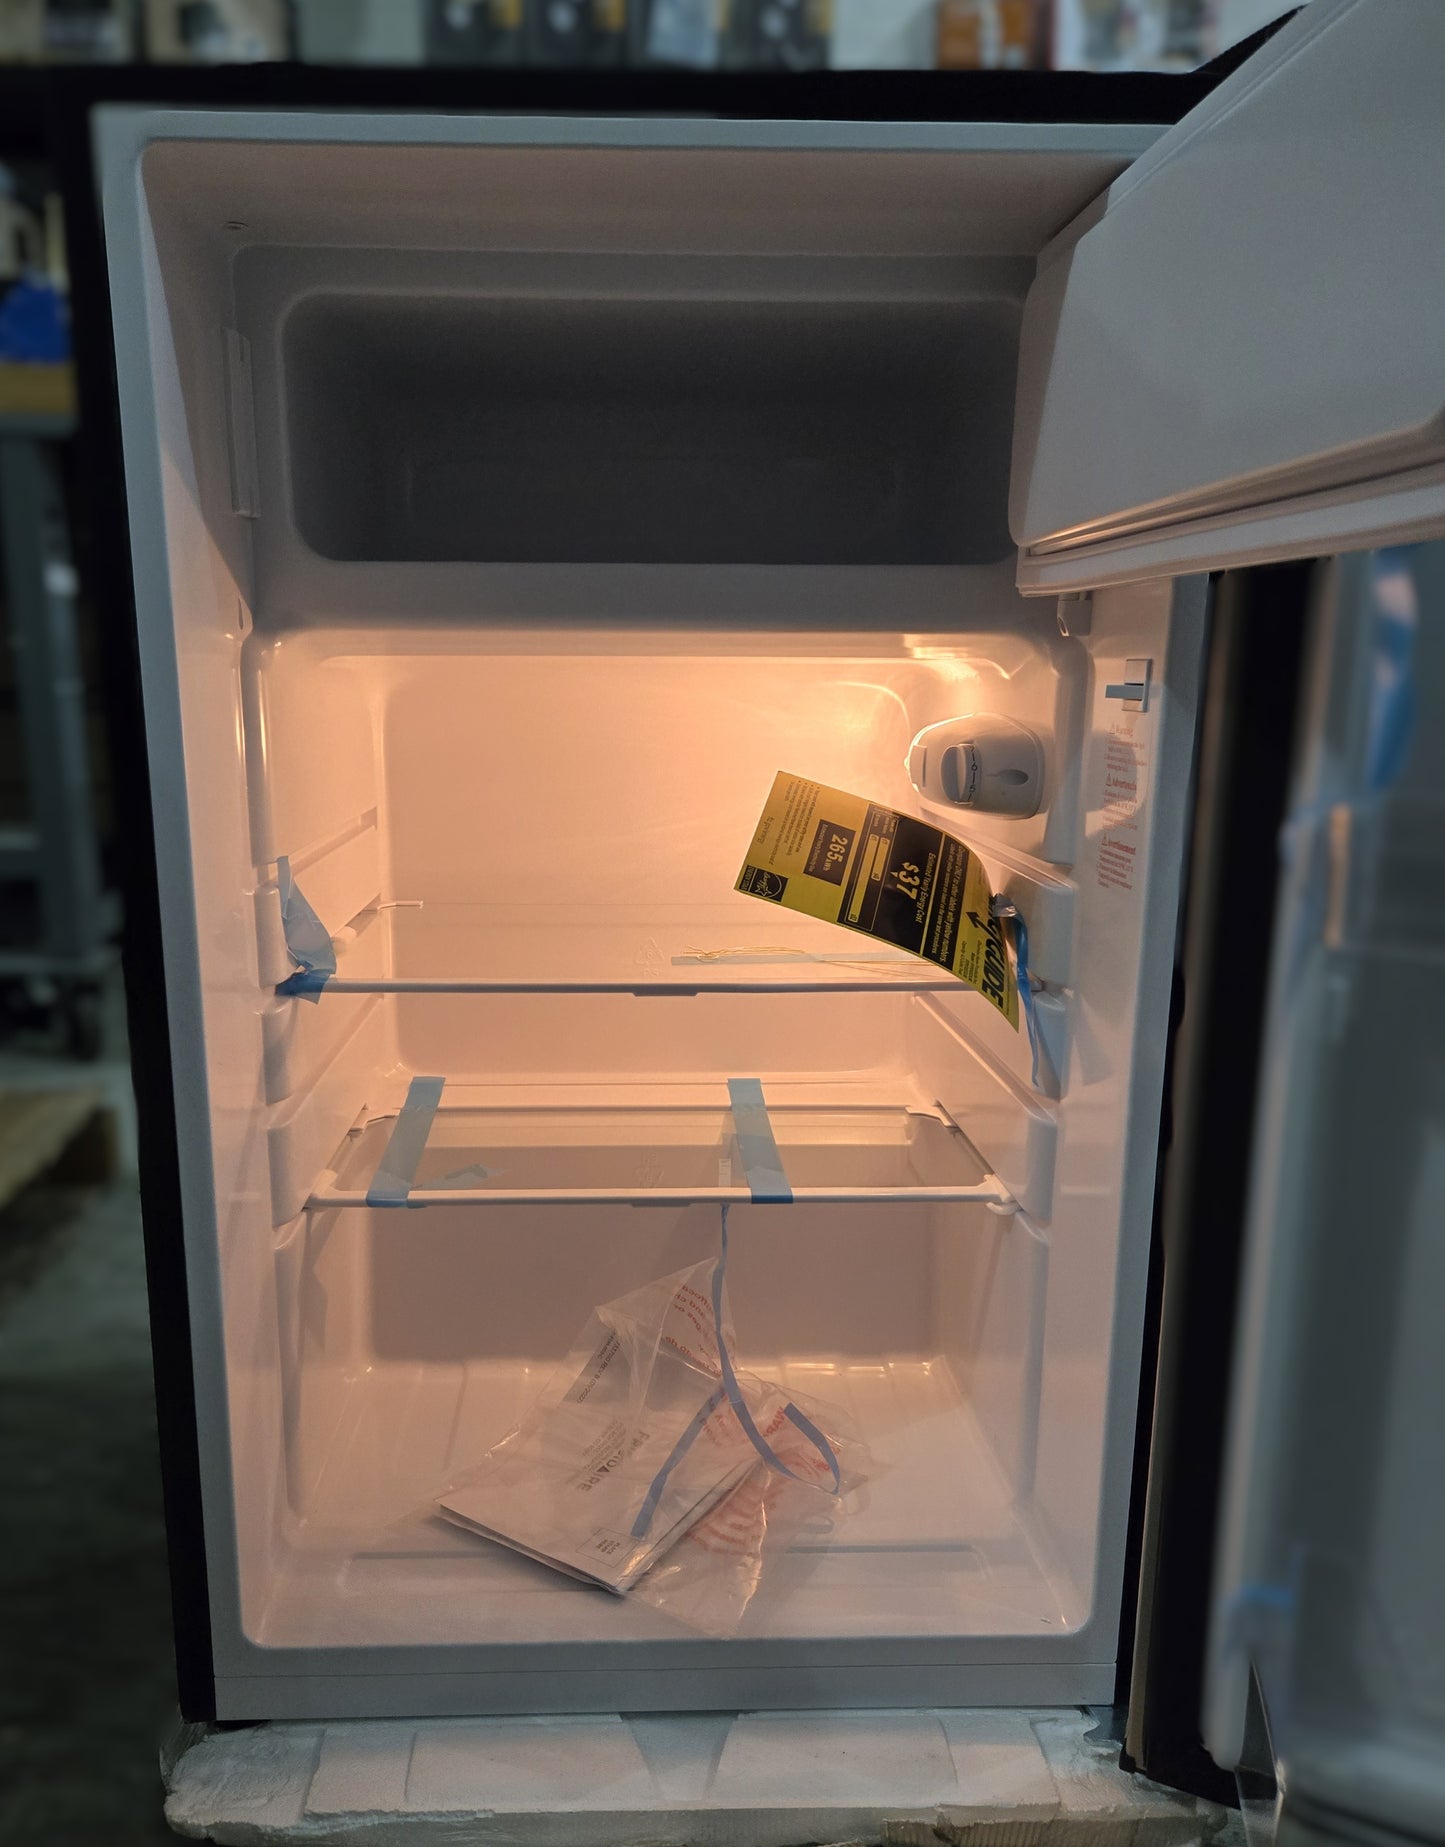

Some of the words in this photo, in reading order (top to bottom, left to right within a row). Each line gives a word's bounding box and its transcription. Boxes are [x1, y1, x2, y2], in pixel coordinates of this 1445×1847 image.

[971, 763, 978, 771] 6
[826, 834, 848, 863] 265
[923, 852, 936, 876] Estimated
[897, 862, 920, 900] $37
[915, 890, 928, 910] Energy
[914, 909, 925, 923] Cost
[946, 911, 955, 922] with
[941, 921, 953, 939] yellow
